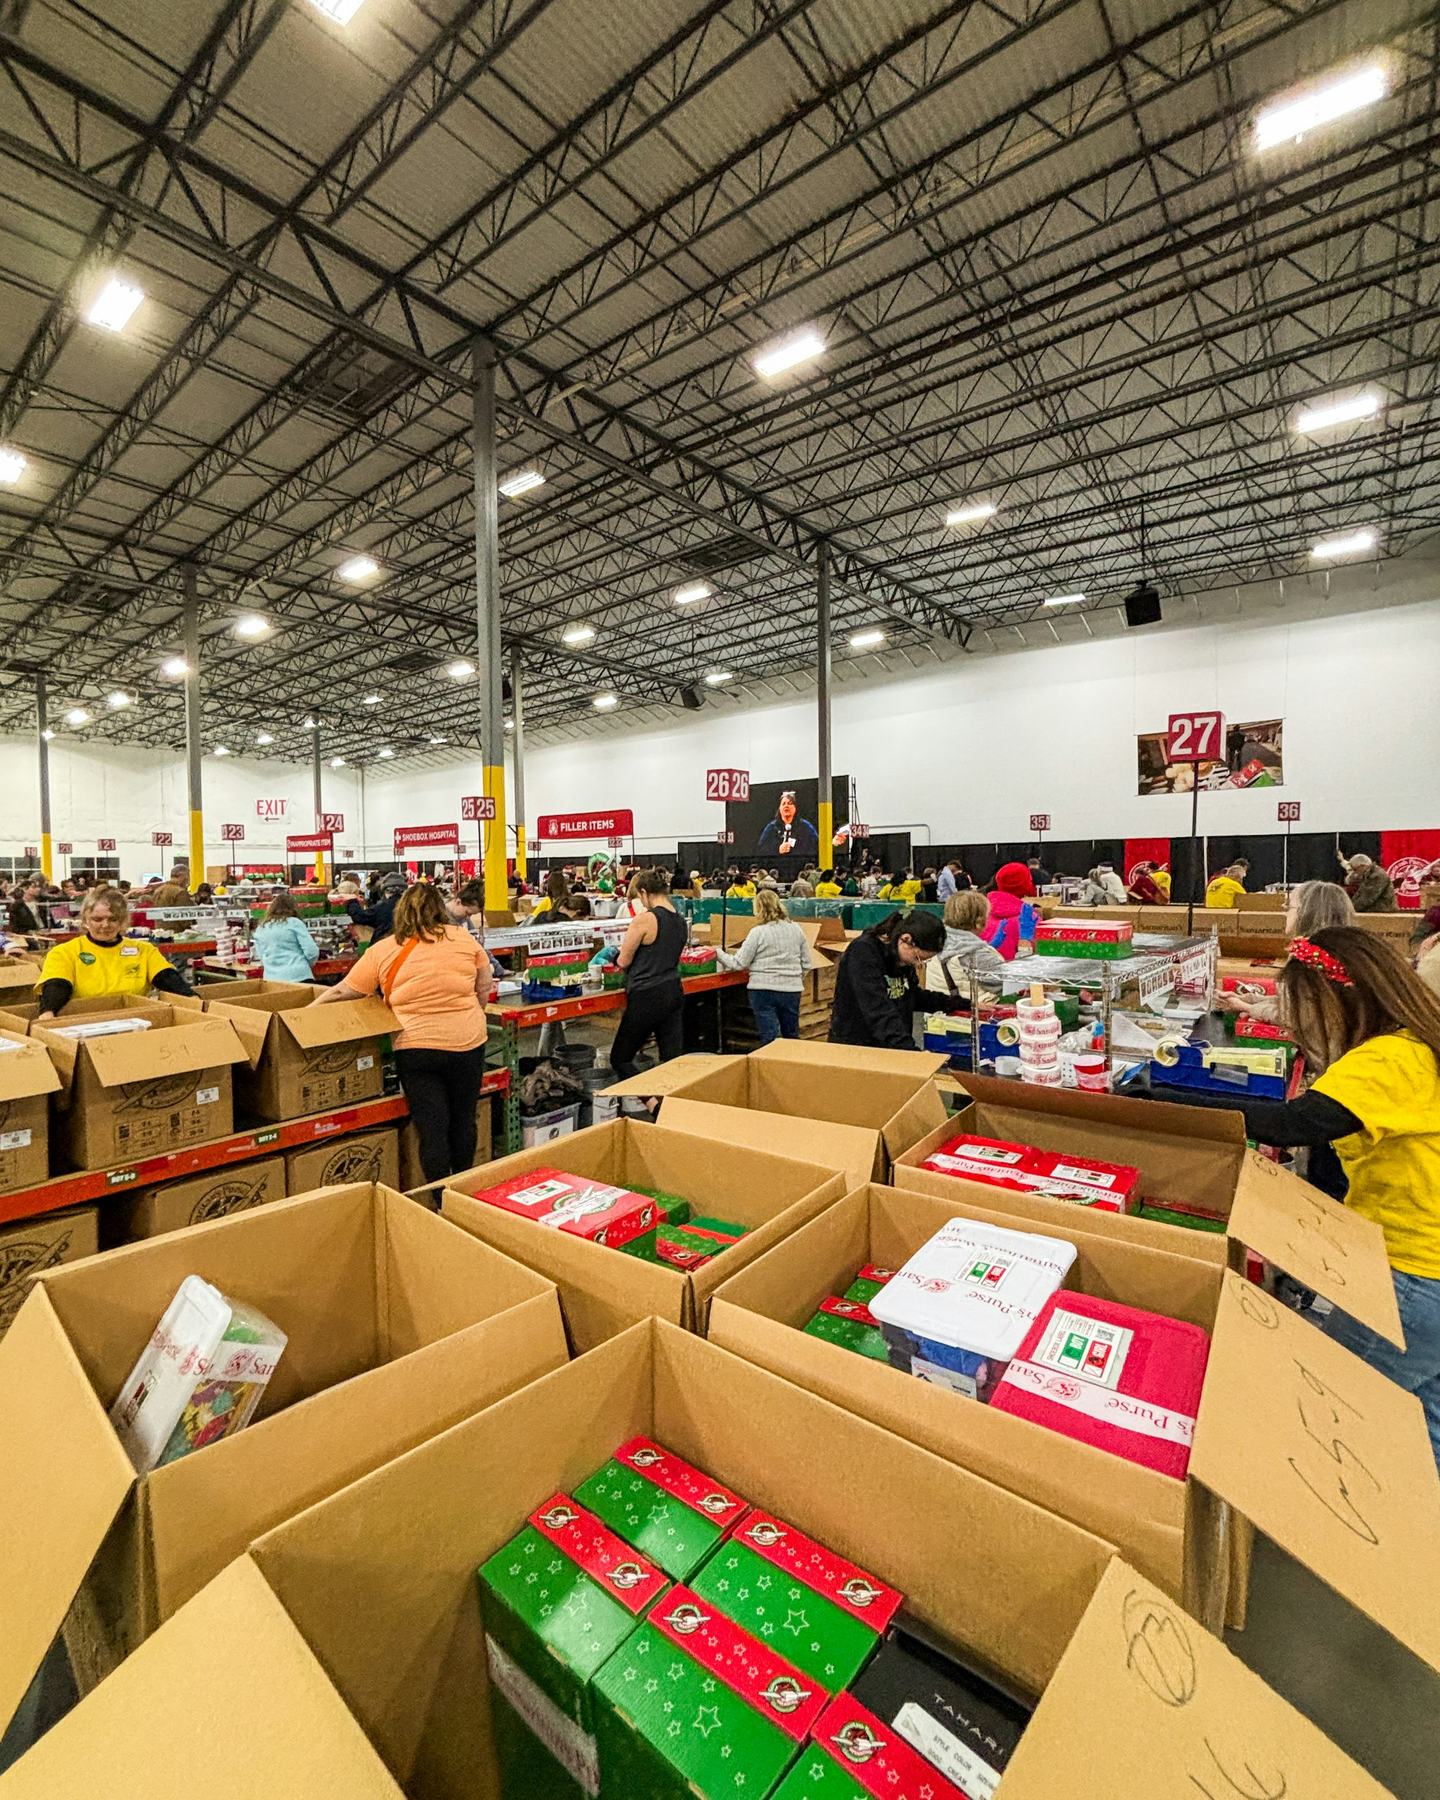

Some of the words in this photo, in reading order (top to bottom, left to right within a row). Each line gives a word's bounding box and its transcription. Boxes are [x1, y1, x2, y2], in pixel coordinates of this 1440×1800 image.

[1169, 716, 1217, 756] 27
[707, 772, 730, 798] 26
[731, 773, 749, 798] 26
[256, 799, 287, 815] EXIT
[462, 799, 475, 818] 25
[476, 798, 496, 818] 25
[1278, 803, 1300, 819] 36
[326, 815, 344, 831] 24
[560, 821, 587, 832] FILLER
[589, 819, 615, 831] ITEMS
[1030, 816, 1045, 830] 35
[158, 833, 172, 846] 22
[228, 826, 244, 839] 23
[401, 832, 428, 843] SHOEBOX
[429, 829, 457, 840] HOSPITAL
[103, 840, 116, 850] 21
[1104, 1396, 1170, 1431] Purse
